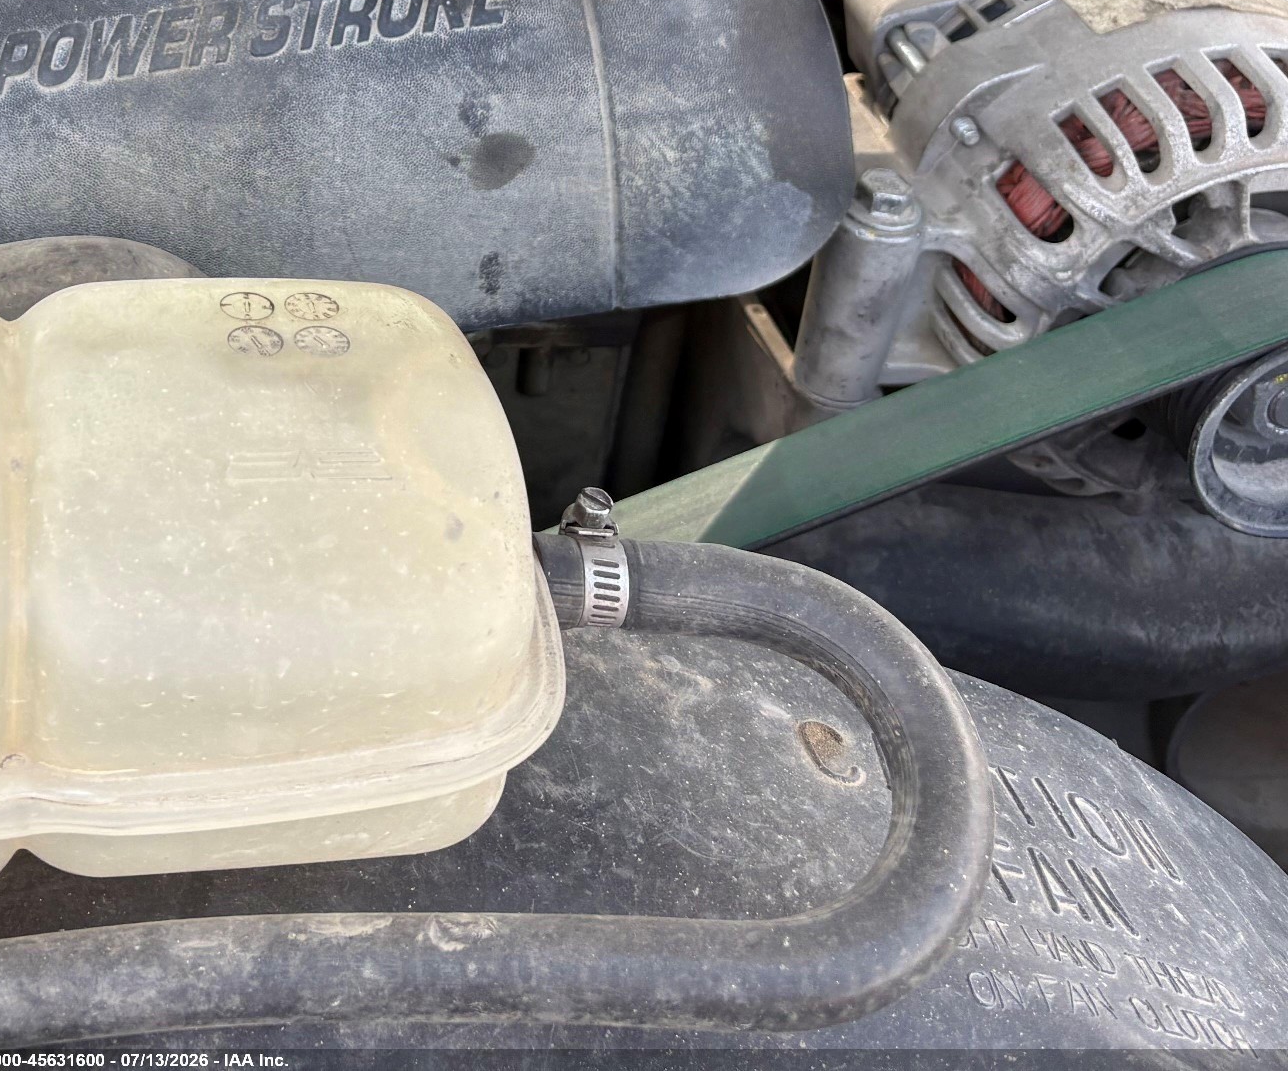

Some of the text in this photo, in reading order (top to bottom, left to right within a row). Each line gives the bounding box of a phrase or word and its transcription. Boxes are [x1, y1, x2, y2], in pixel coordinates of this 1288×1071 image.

[966, 970, 1260, 1060] ON FAN CLUTCH
[1019, 924, 1118, 976] HAND
[1122, 950, 1246, 1016] THREAD
